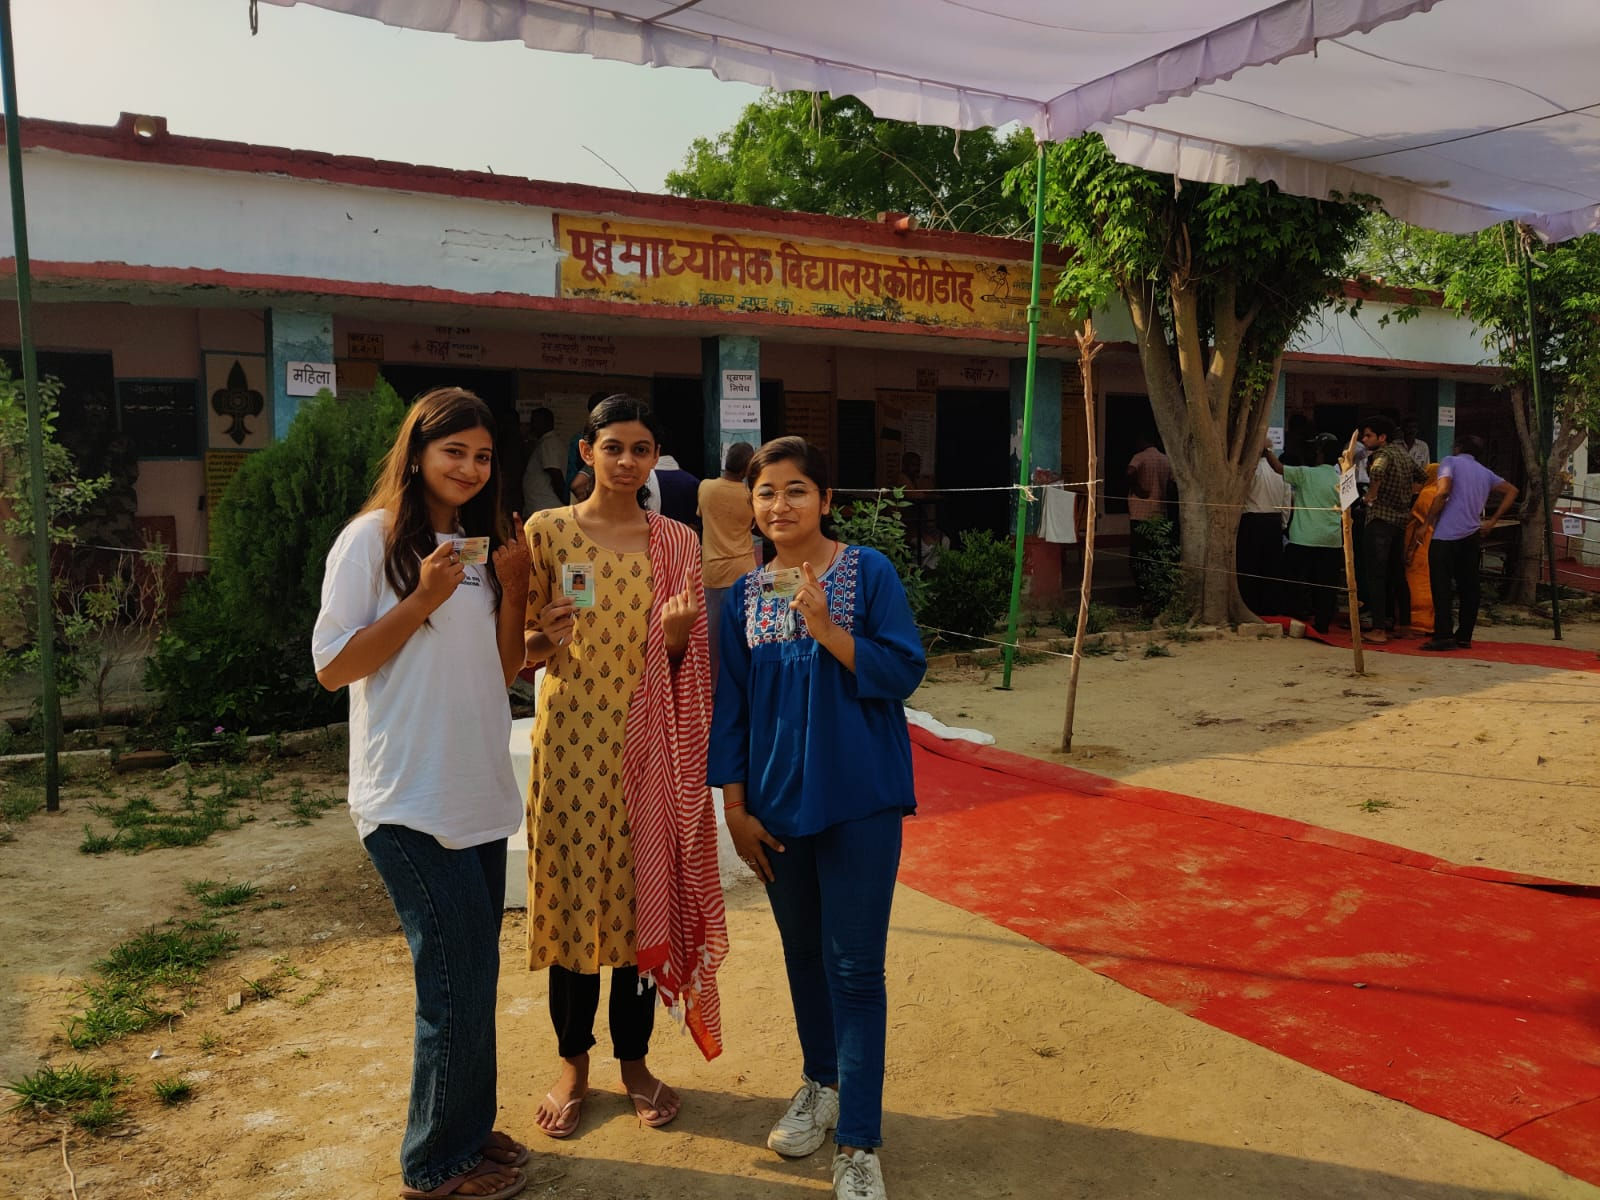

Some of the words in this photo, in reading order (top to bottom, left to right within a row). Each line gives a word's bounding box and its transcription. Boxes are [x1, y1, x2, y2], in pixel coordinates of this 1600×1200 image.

[617, 233, 774, 286] माध्यमिक
[777, 242, 882, 300] विद्यालय
[293, 364, 331, 385] महिला
